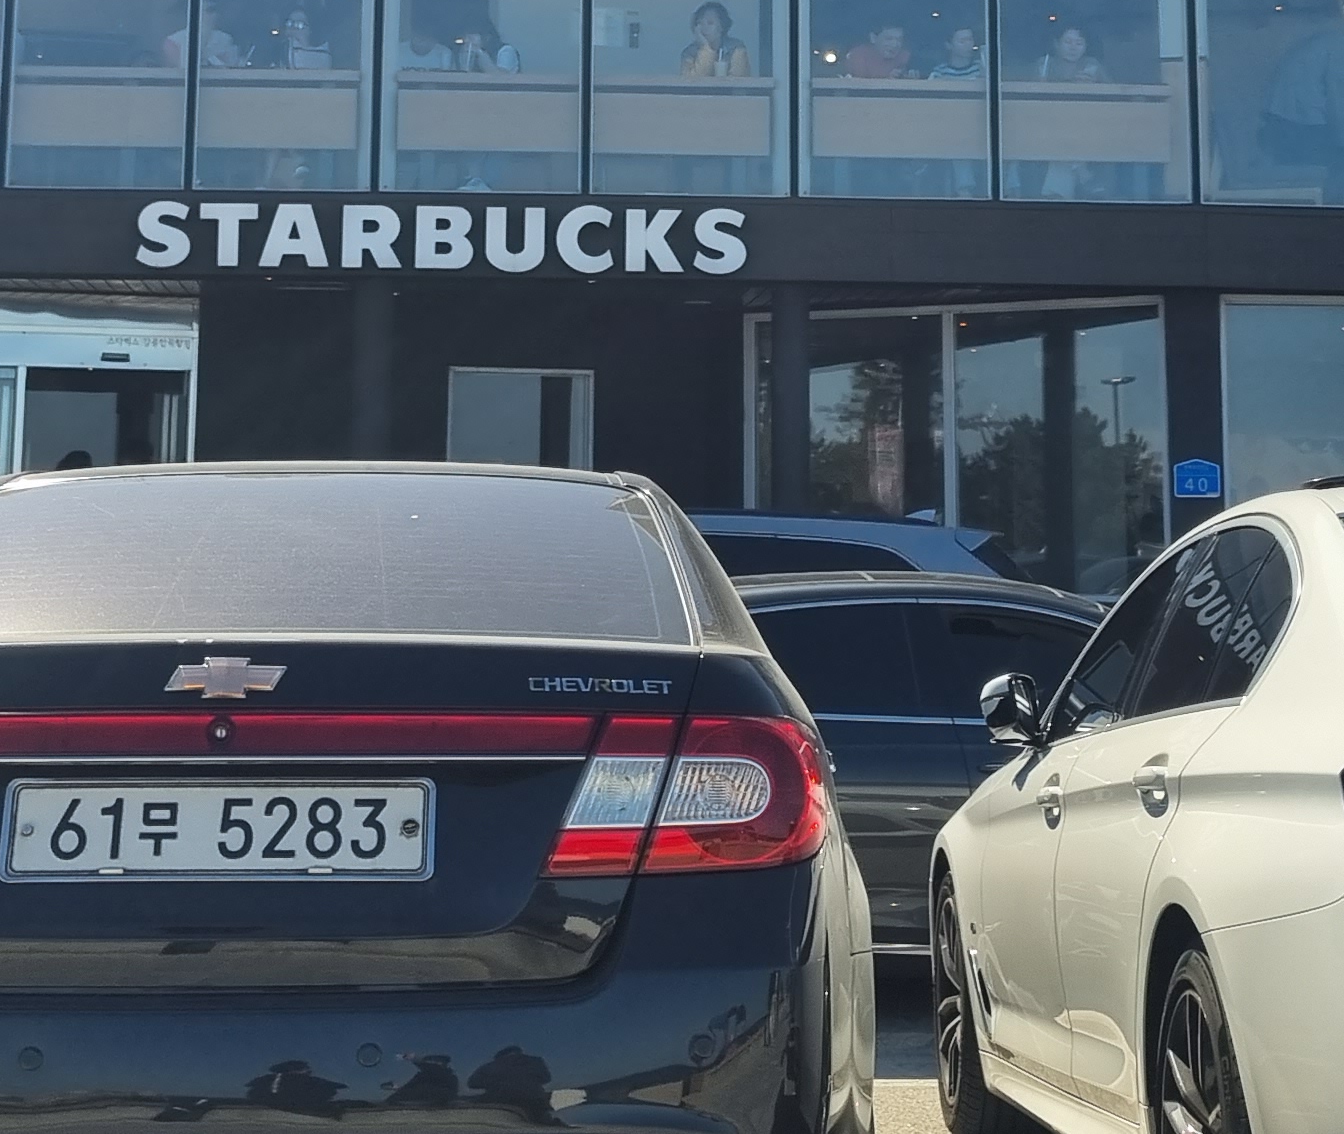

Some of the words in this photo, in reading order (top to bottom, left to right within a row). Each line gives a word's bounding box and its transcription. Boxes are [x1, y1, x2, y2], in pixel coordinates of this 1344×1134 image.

[135, 201, 748, 275] STARBUCKS
[1184, 477, 1208, 492] 40
[528, 677, 672, 694] CHEVROLET
[50, 797, 178, 860] 61무
[217, 797, 387, 859] 5283
